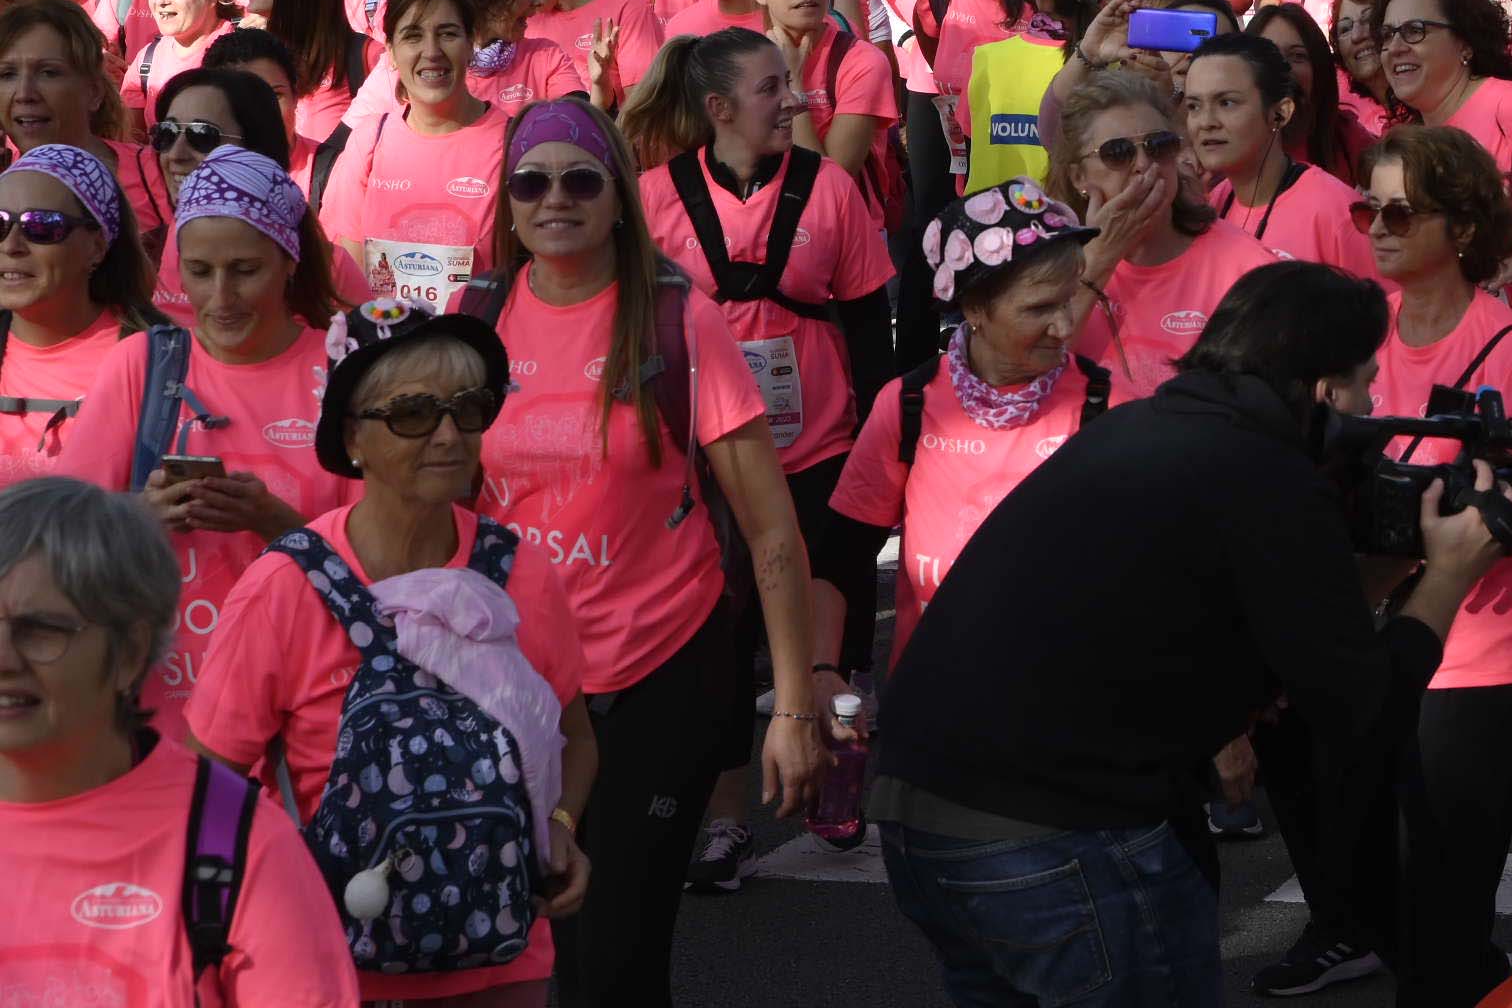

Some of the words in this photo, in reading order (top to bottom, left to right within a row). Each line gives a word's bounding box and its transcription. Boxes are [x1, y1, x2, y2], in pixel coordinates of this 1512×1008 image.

[451, 182, 486, 193] ASTURIANA
[399, 259, 440, 272] ASTURIANA
[400, 284, 438, 302] 016
[923, 433, 986, 455] OYSHO
[80, 897, 156, 917] ASTURIANA
